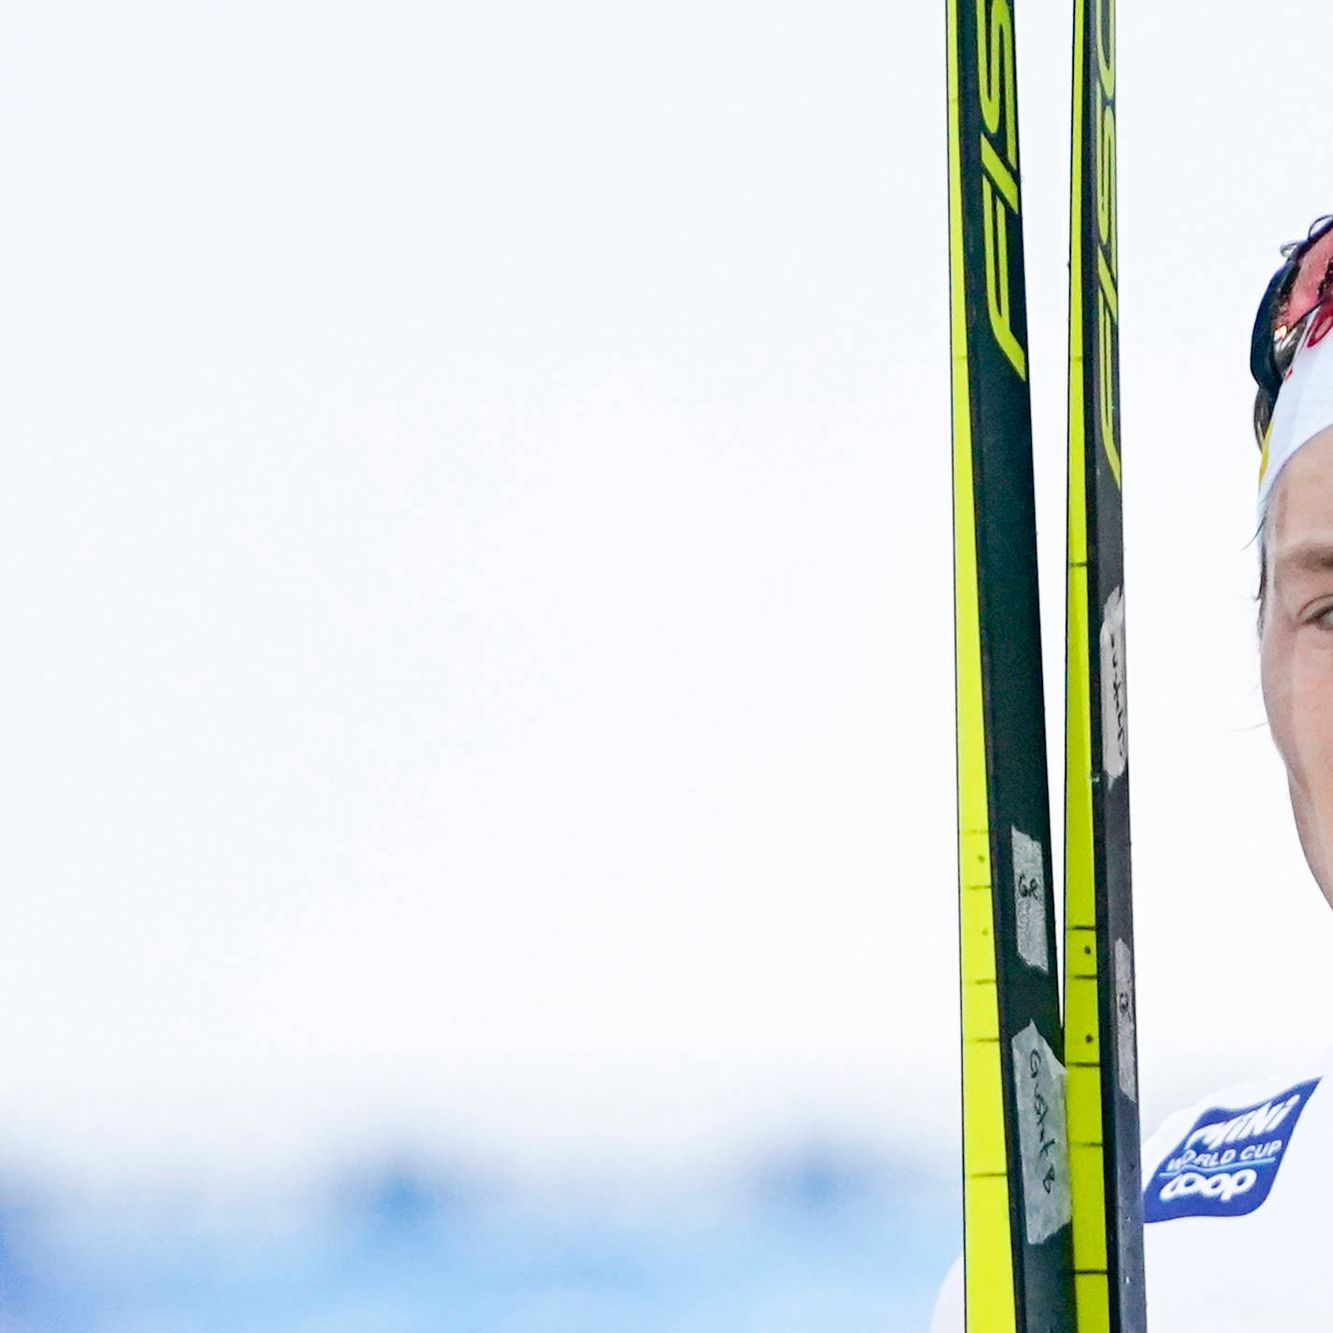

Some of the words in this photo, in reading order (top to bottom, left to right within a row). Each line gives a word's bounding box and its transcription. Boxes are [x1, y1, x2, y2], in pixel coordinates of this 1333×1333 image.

[1167, 1149, 1236, 1173] WORLD
[1239, 1140, 1283, 1161] CUP
[1159, 1168, 1258, 1203] coop
